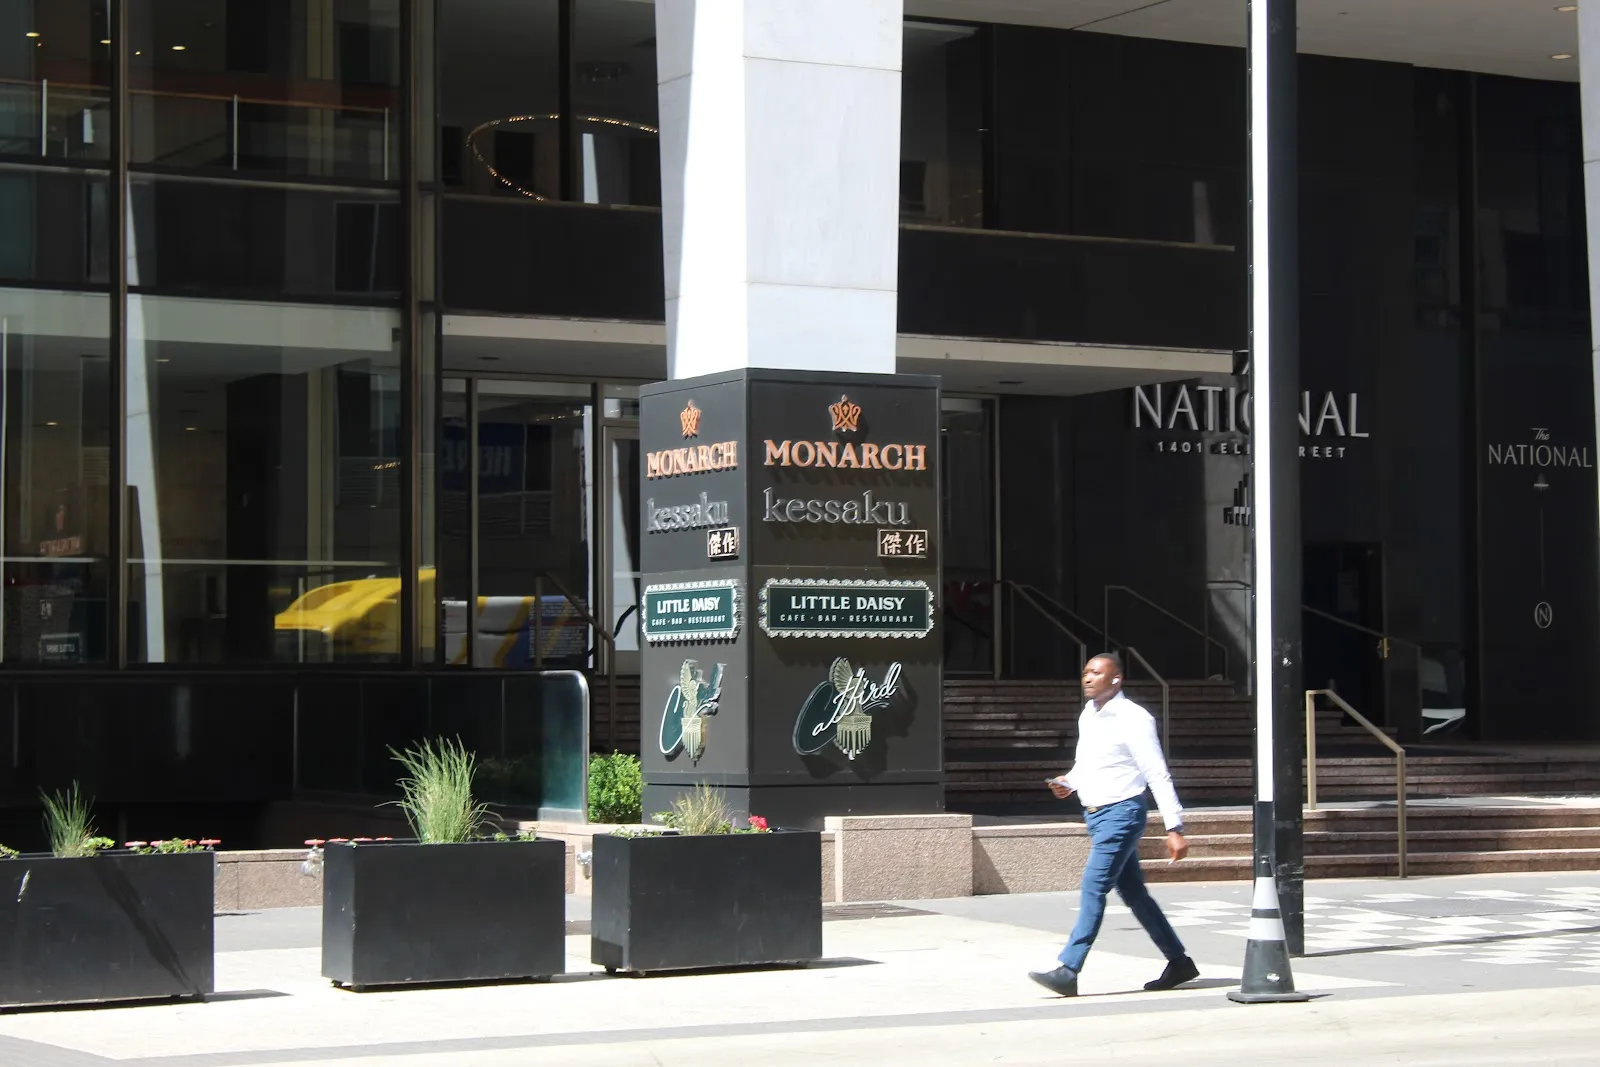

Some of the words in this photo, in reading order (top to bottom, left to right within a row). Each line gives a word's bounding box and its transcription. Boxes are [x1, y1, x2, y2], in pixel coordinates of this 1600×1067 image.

[1134, 383, 1370, 438] NATINAL
[1532, 427, 1550, 441] The
[646, 440, 738, 478] MONARCH
[763, 439, 927, 471] MONARCH
[1157, 441, 1202, 453] 1401
[1221, 442, 1250, 454] EL
[1298, 446, 1346, 458] REET
[1488, 443, 1593, 468] NATIONAL
[646, 491, 730, 532] kessaku
[762, 487, 911, 526] kessaku
[880, 533, 926, 555] 傑作
[657, 598, 690, 614] LITTLE
[691, 596, 721, 612] DAISY
[790, 595, 851, 610] LITTLE
[856, 596, 906, 611] DAISY
[651, 618, 666, 627] CAFE
[780, 614, 806, 622] CAFE
[817, 614, 838, 623] BAR
[849, 615, 915, 623] RESTAURANT
